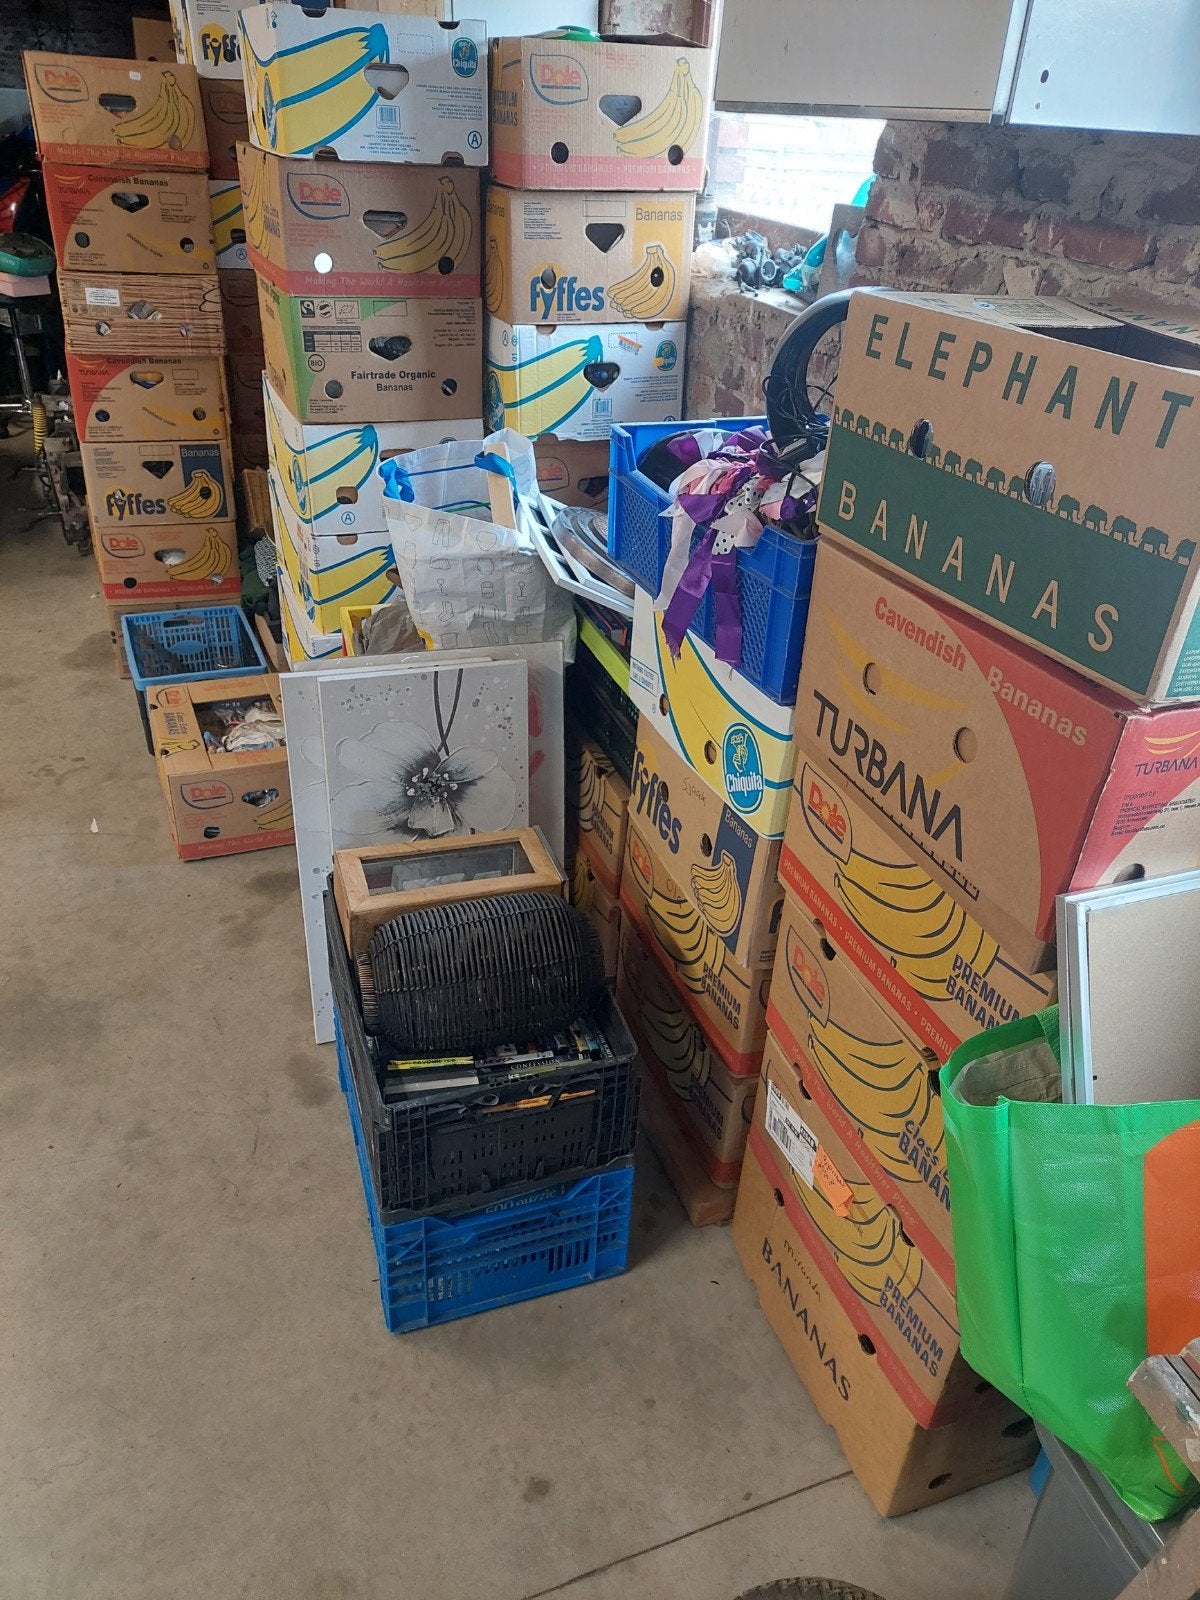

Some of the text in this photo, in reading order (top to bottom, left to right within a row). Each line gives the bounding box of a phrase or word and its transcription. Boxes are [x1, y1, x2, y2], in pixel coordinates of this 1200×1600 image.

[44, 70, 80, 87] Dole
[539, 64, 581, 86] Dole
[88, 174, 169, 187] Cavendish Bananas
[299, 182, 342, 202] Dole
[635, 207, 683, 222] Bananas
[305, 276, 337, 289] Making
[341, 277, 356, 286] The
[530, 276, 605, 320] fyffes
[106, 357, 182, 366] Cavendish Bananas
[310, 359, 323, 367] BIO
[351, 370, 436, 381] Fairtrade Organic
[865, 313, 1194, 449] ELEPHANT
[376, 383, 413, 392] Bananas
[181, 448, 220, 458] Bananas
[106, 492, 167, 521] fyffes
[109, 537, 138, 548] Dole
[837, 480, 1119, 652] BANANAS
[874, 596, 966, 672] Cavendish
[985, 664, 1089, 747] Bananas
[726, 771, 763, 797] Chiquita
[813, 690, 964, 862] TURBANA
[1135, 756, 1198, 777] TURBANA
[190, 786, 226, 799] Dole
[631, 750, 683, 854] fyffes
[809, 780, 847, 839] Dole
[724, 809, 753, 849] Bananas
[631, 841, 651, 883] Dole
[783, 859, 952, 1056] PREMIUM BANANAS PREMIUM BANANAS PREMIU
[792, 944, 826, 1002] Dole
[700, 976, 740, 1031] BANANAS
[702, 961, 742, 1015] PREMIUM
[904, 1119, 939, 1166] Class
[826, 1098, 847, 1129] World
[855, 1141, 892, 1192] Healthier
[893, 1191, 919, 1230] Place
[760, 1237, 850, 1402] BANANAS
[879, 1289, 938, 1378] BANANAS
[884, 1275, 944, 1362] PREMIUM
